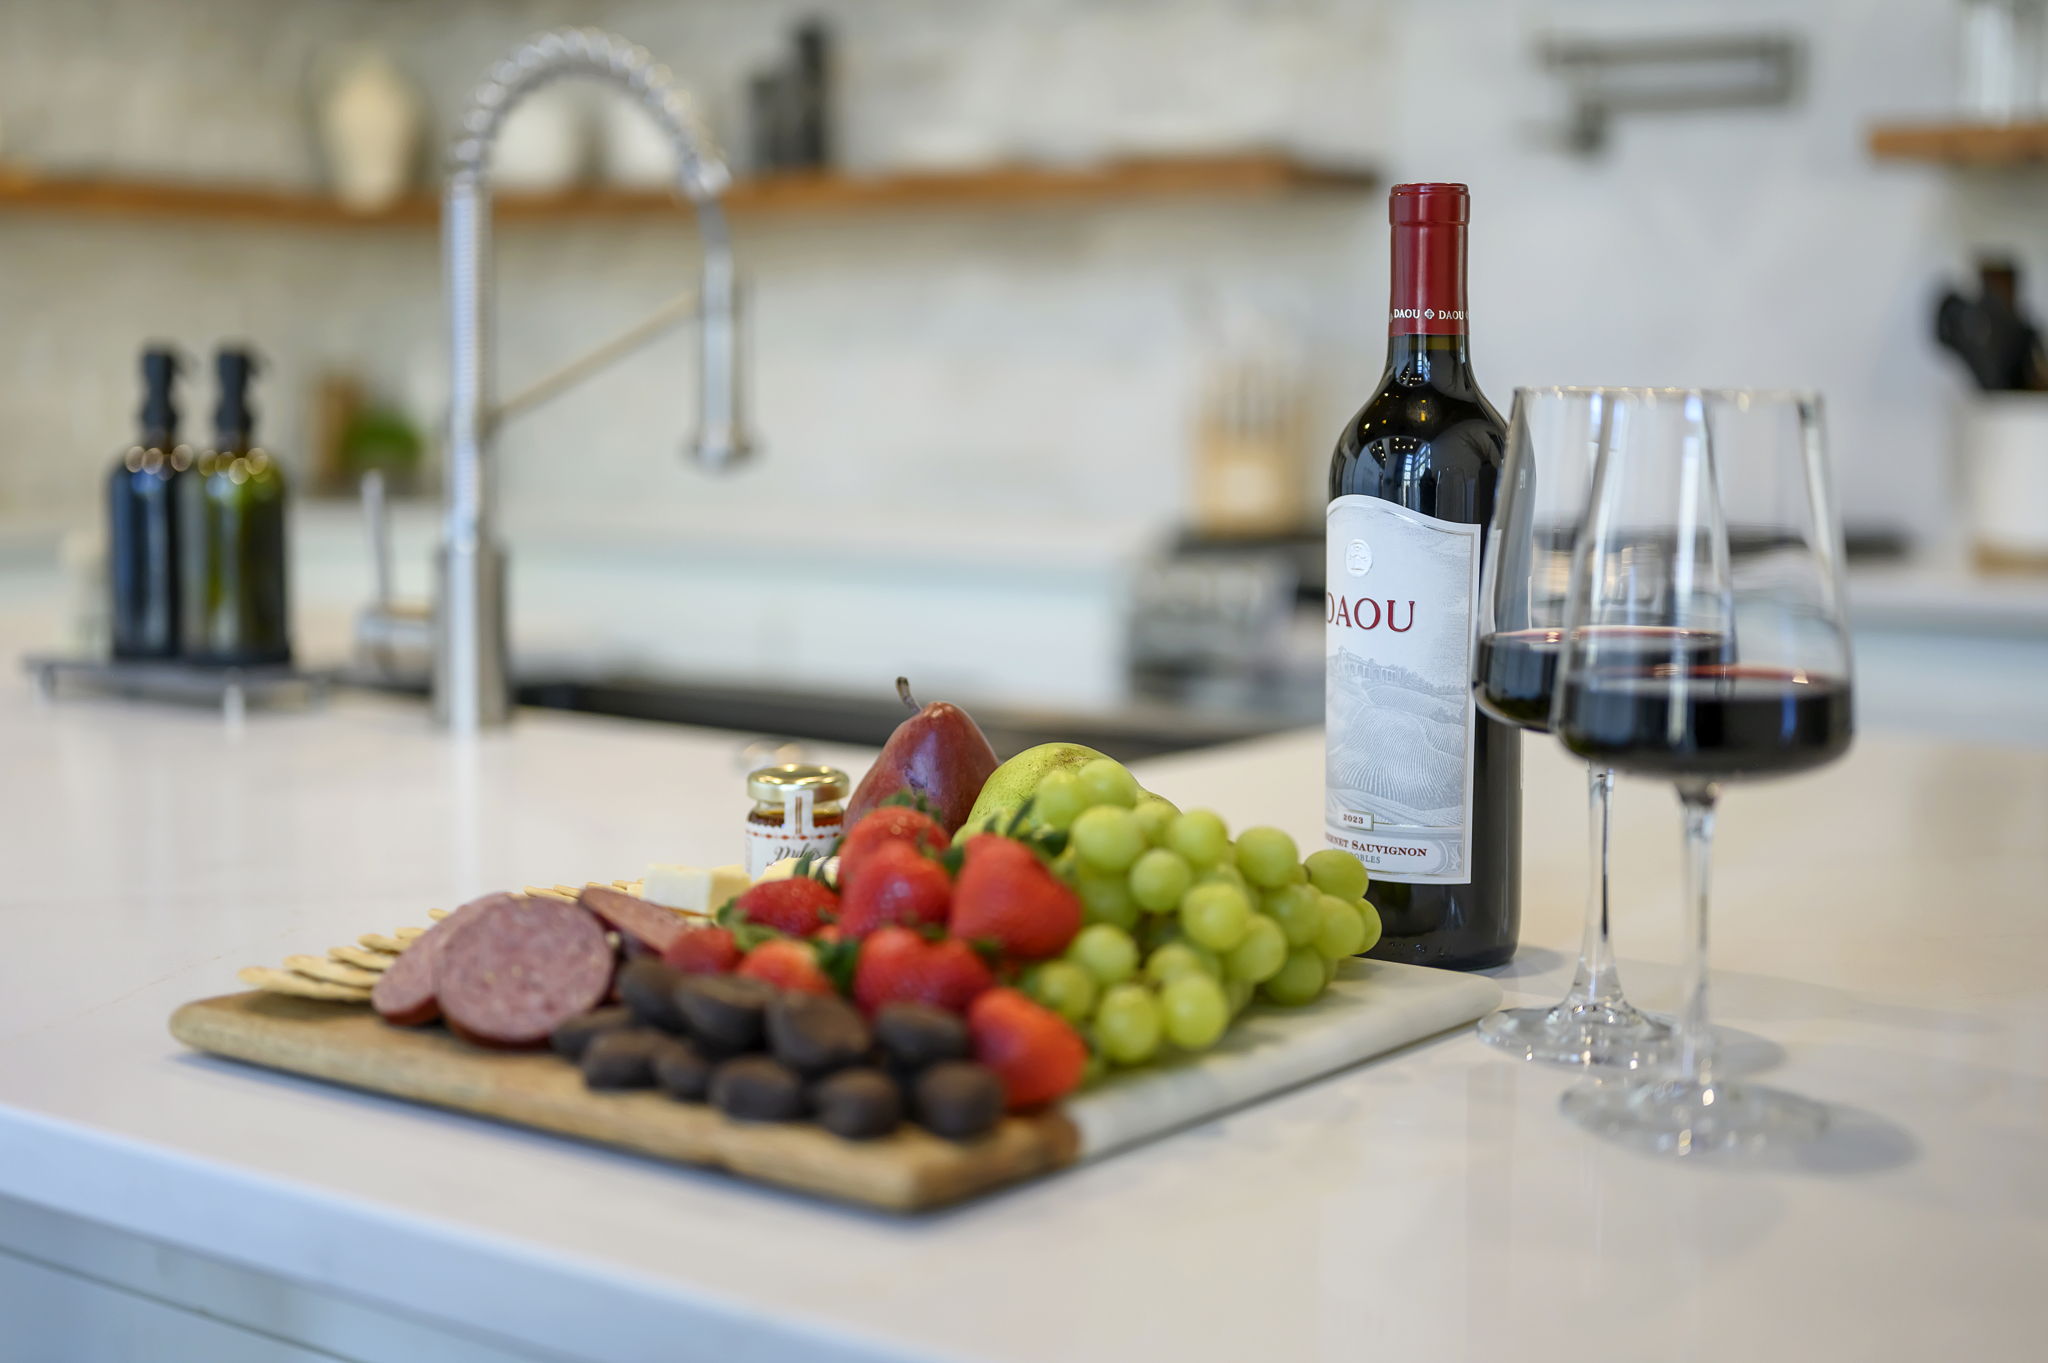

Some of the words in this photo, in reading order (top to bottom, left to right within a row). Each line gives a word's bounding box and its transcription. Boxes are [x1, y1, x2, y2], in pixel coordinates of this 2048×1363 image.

[1394, 308, 1420, 319] DAOU
[1438, 310, 1464, 320] DAOU
[1343, 813, 1364, 825] 2023
[1351, 853, 1381, 864] OBLES
